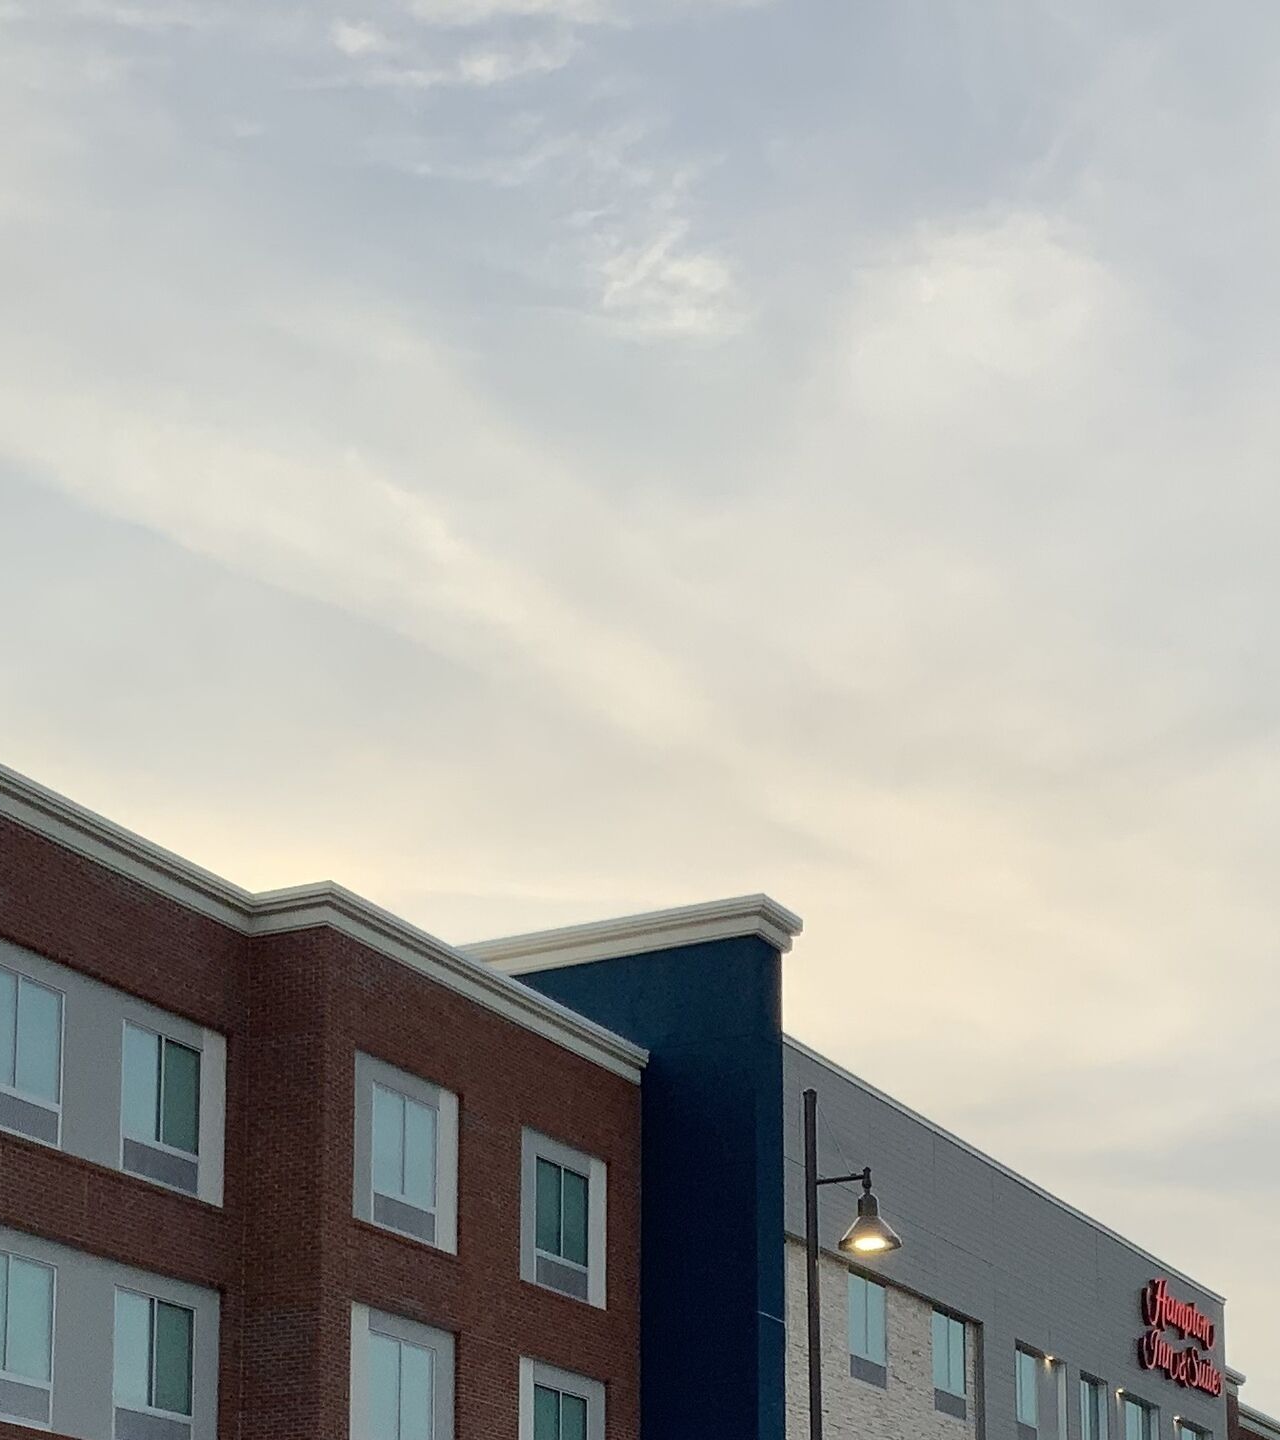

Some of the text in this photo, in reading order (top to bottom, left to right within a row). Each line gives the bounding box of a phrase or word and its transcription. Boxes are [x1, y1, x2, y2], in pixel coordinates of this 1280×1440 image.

[1143, 1279, 1216, 1349] Hampton
[1139, 1329, 1180, 1380] Inn
[1187, 1346, 1223, 1397] Suites
